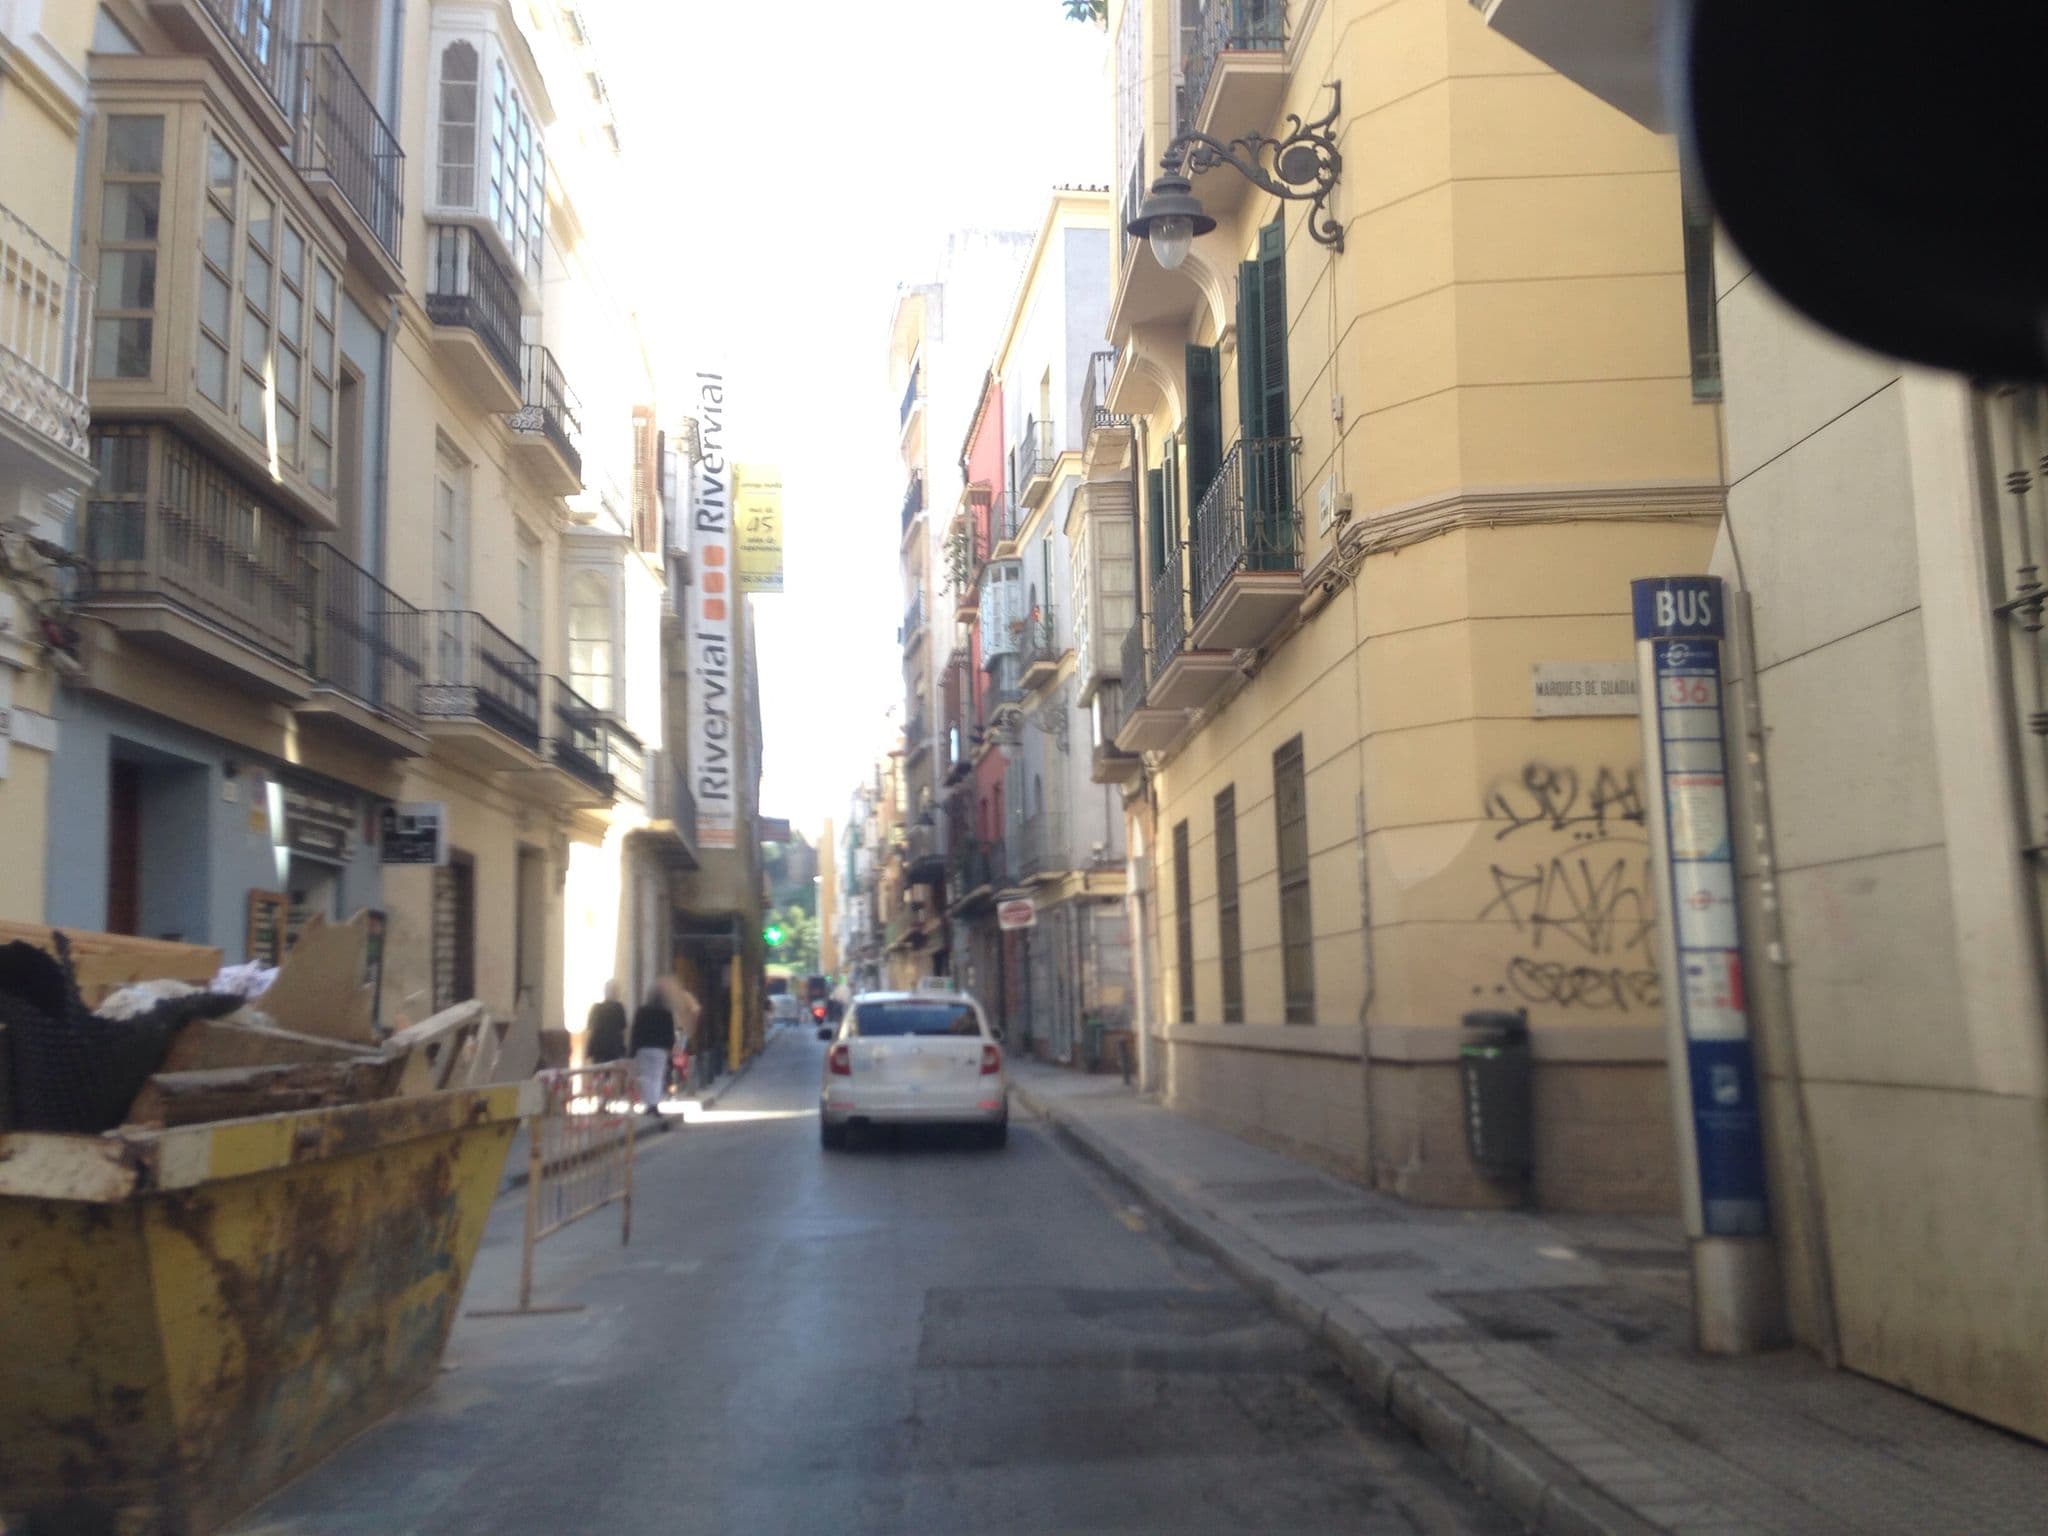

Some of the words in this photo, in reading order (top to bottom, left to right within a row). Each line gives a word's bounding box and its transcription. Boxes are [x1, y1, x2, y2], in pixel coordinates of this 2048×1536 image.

[695, 372, 724, 533] Rivervial
[1655, 589, 1712, 626] BUS
[1584, 680, 1599, 696] DE
[1600, 680, 1638, 696] GUADIA
[1668, 677, 1713, 704] 36
[696, 632, 729, 799] Rivervial
